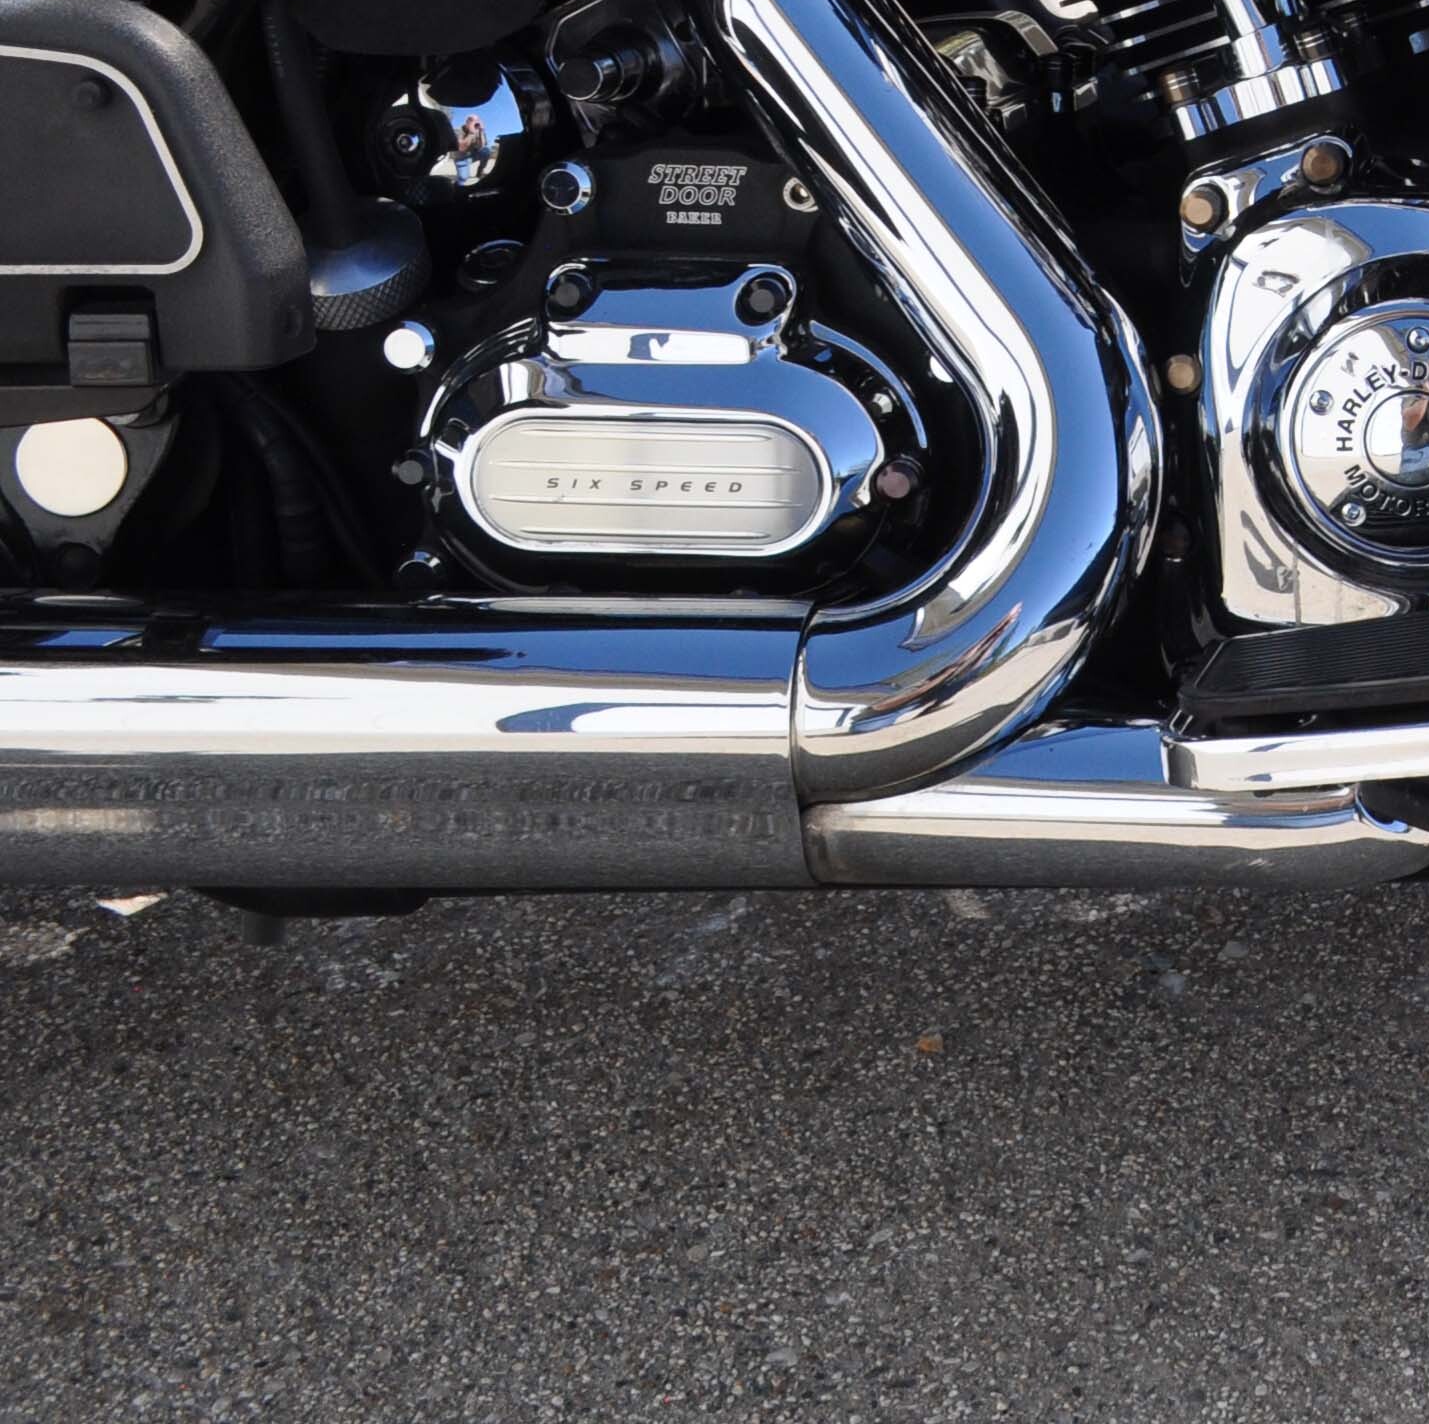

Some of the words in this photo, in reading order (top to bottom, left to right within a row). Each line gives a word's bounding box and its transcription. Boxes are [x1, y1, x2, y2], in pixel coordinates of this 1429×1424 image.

[647, 163, 748, 187] STREET
[658, 185, 738, 206] DOOR
[665, 210, 723, 225] BAKER
[546, 476, 602, 490] SIX
[629, 479, 744, 494] SPEED
